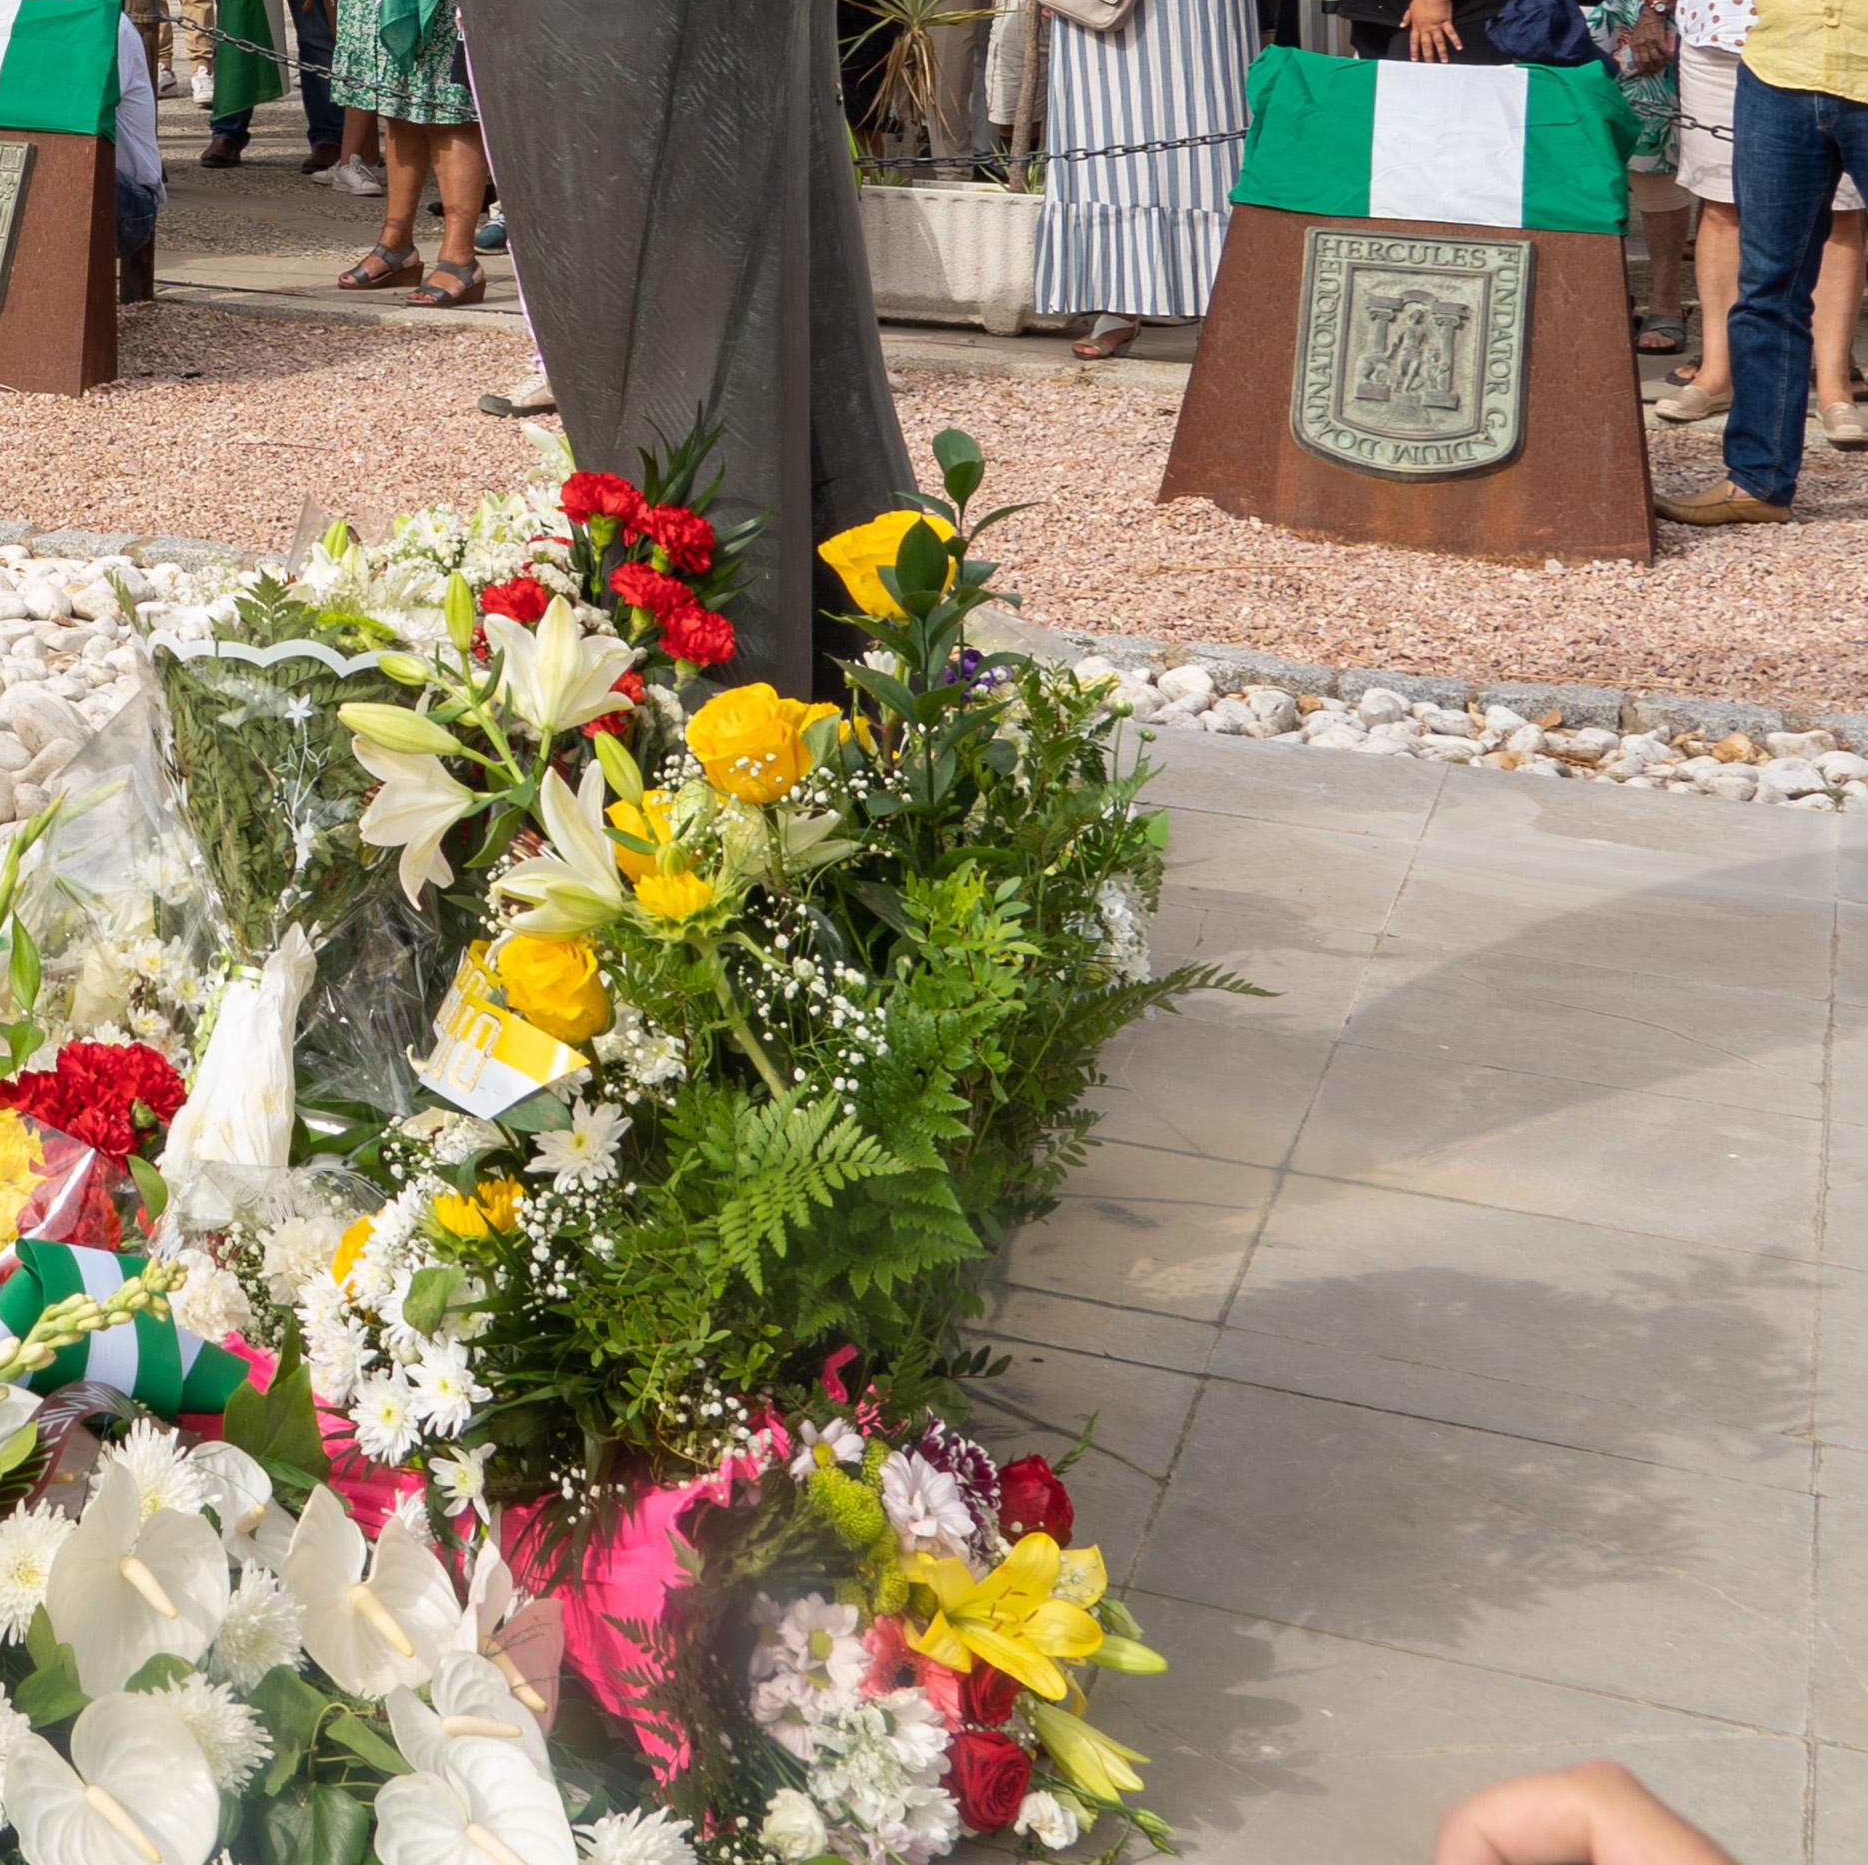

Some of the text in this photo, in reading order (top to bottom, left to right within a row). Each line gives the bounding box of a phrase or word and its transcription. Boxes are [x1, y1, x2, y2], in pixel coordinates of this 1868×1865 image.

[1305, 237, 1522, 466] HERCULES FUNDATOR GADIUM DOMINATORQUE
